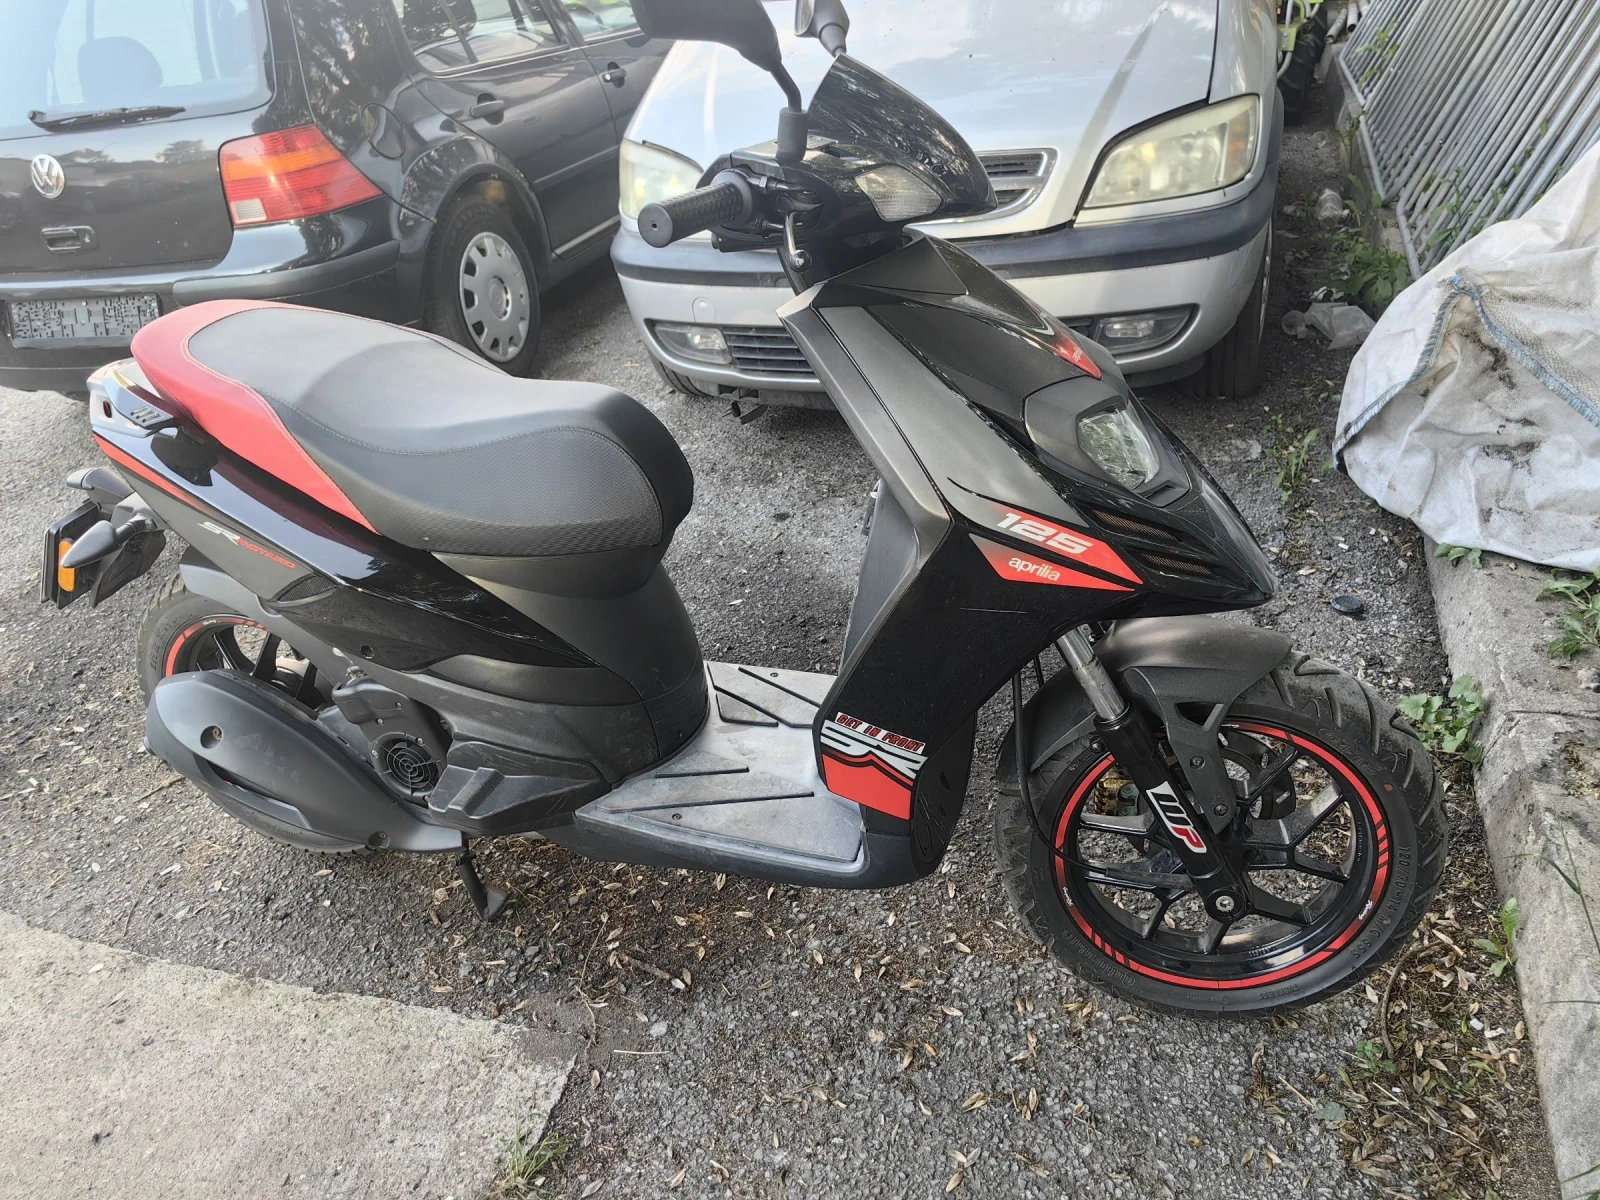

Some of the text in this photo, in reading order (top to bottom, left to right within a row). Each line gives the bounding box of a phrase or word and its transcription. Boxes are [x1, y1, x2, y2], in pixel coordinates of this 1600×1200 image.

[31, 154, 65, 199] VW
[997, 512, 1093, 554] 125
[1008, 557, 1061, 582] aprilia
[820, 719, 929, 780] SR
[836, 714, 925, 753] GET IN FRONT
[1146, 781, 1207, 853] WP
